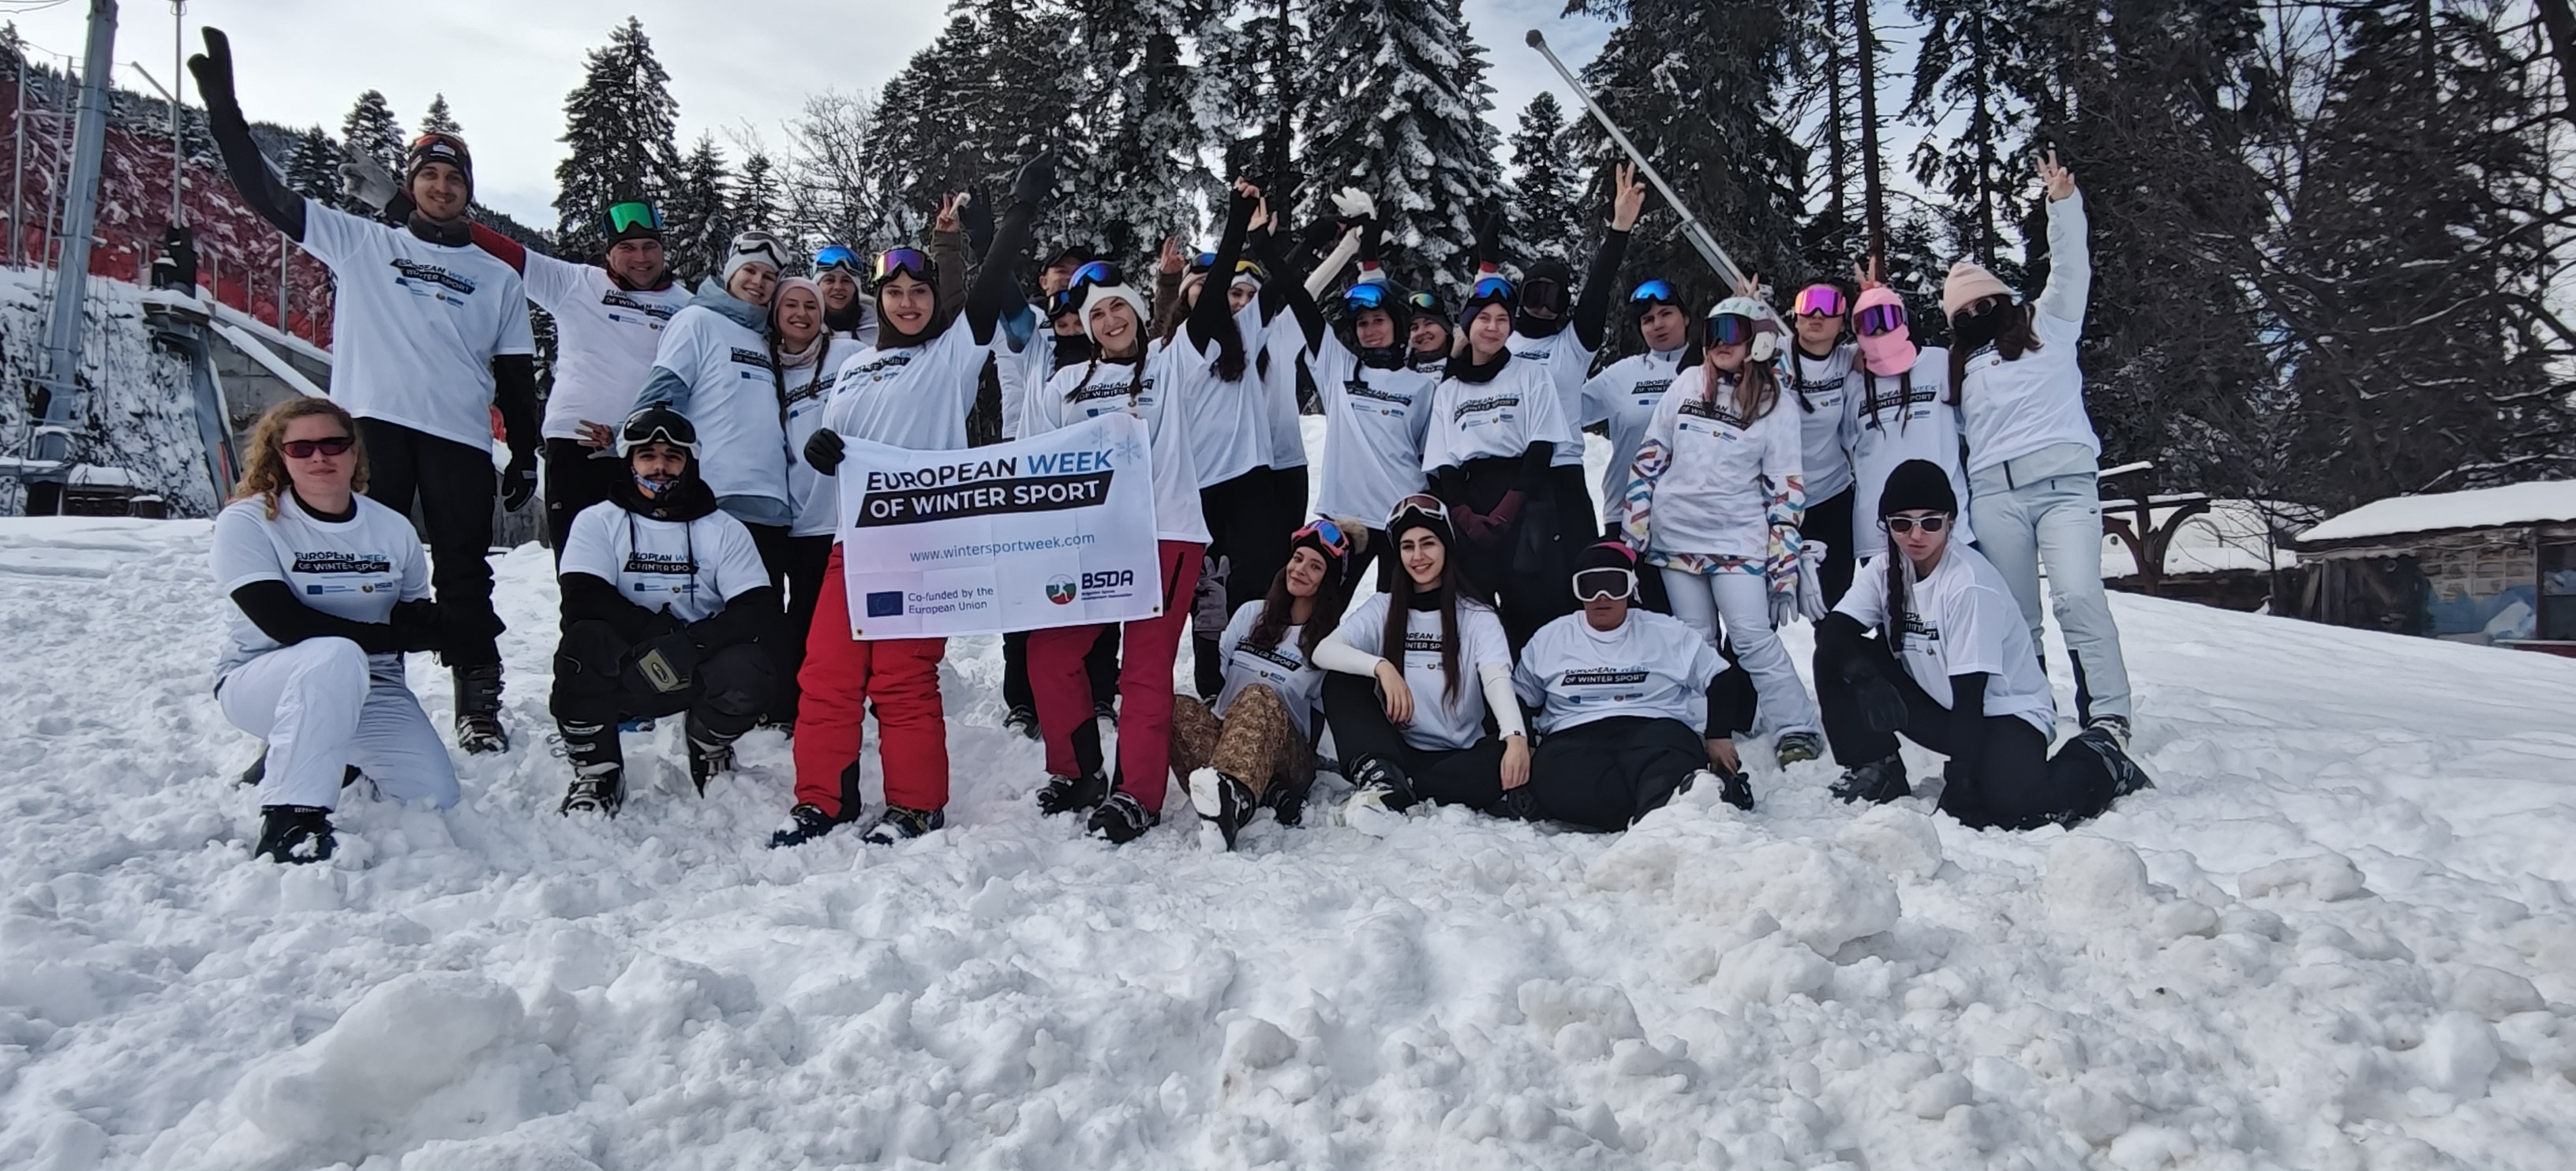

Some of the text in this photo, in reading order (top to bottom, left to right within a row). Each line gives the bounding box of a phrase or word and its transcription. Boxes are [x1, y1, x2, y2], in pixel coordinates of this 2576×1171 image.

[1877, 397, 1903, 408] INTER
[866, 448, 1114, 491] EUROPEAN WEEK
[870, 480, 1100, 518] OF WINTER SPORT
[909, 533, 1095, 562] www.wintersportweek.com
[294, 552, 355, 562] EUROPEAN
[629, 552, 672, 562] EOPEAN
[1081, 569, 1134, 589] BSDA
[908, 586, 994, 602] Co-funded by the
[908, 600, 987, 615] European Union
[1240, 645, 1297, 669] WINTER SPORT
[1615, 674, 1645, 683] SPORT
